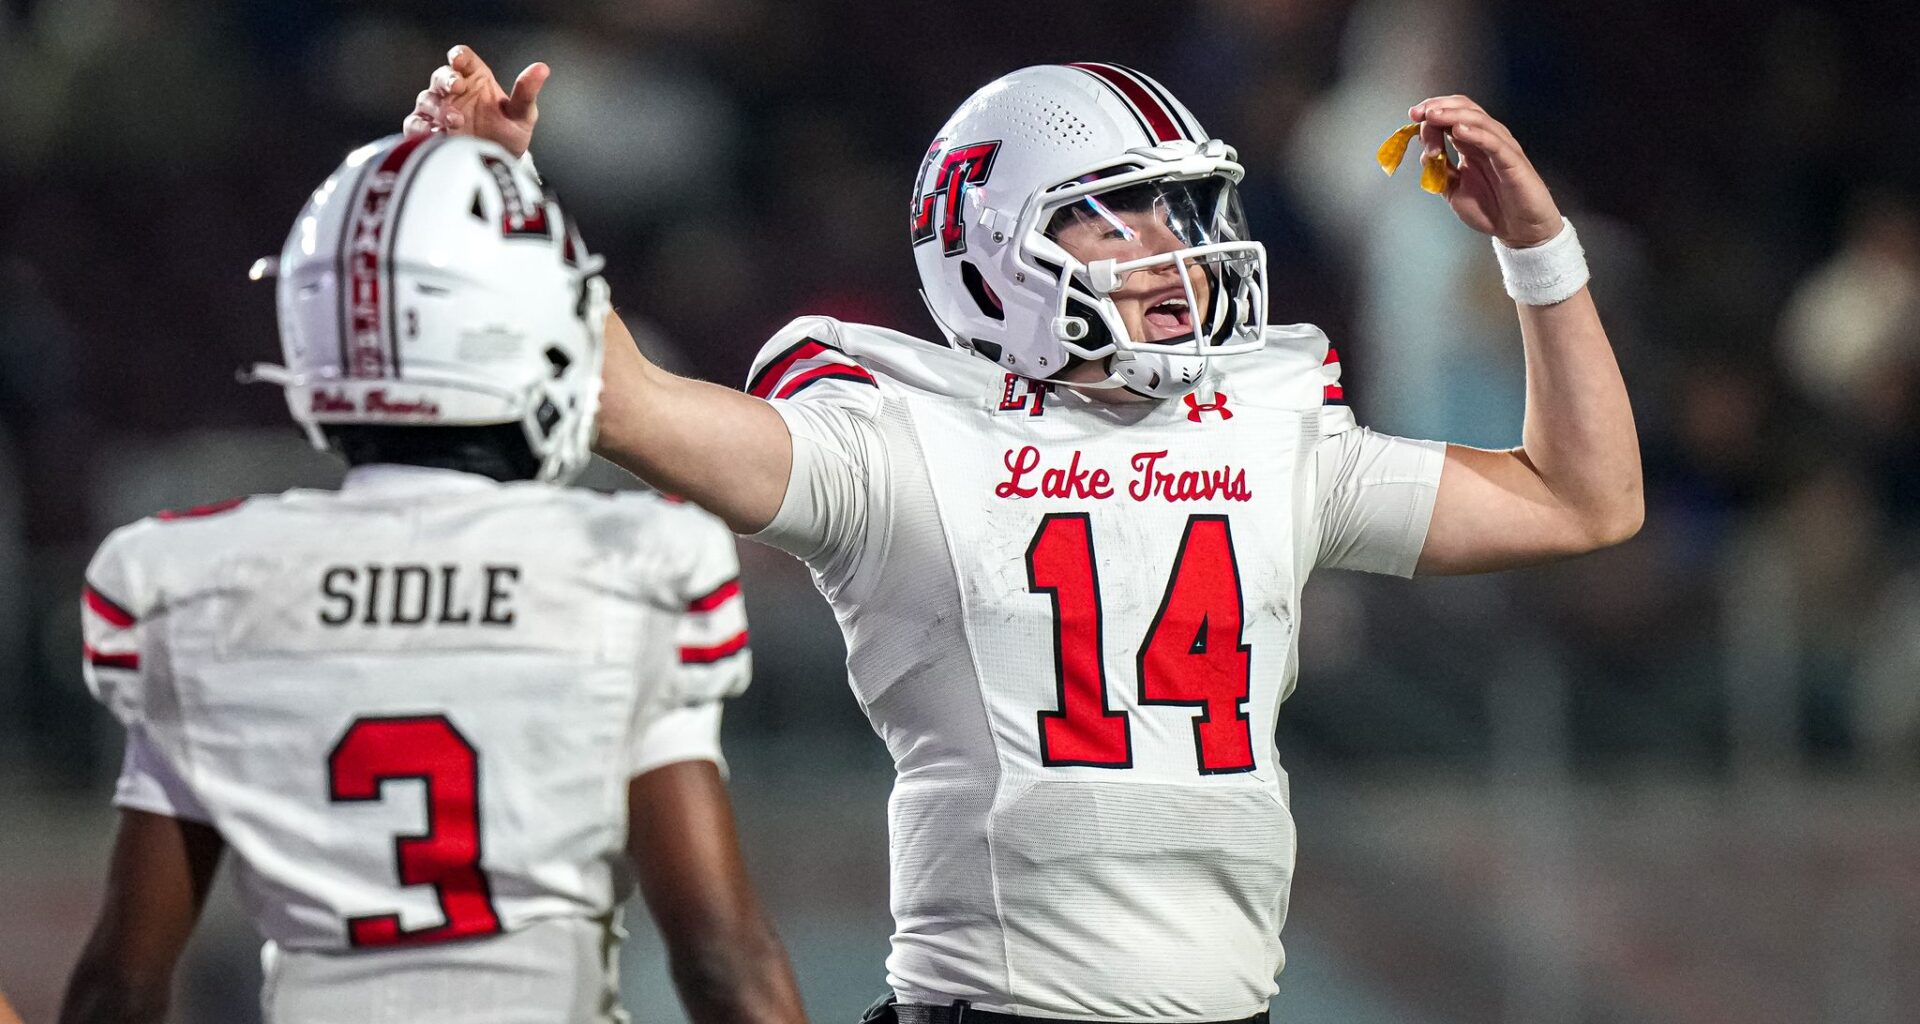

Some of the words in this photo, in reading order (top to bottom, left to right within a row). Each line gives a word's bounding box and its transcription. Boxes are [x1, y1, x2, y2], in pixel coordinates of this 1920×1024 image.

[911, 138, 1002, 258] LT
[998, 372, 1056, 417] LT
[995, 445, 1114, 500] Lake
[1128, 450, 1252, 502] Travis
[319, 563, 521, 627] SIDLE
[1025, 511, 1256, 775] 14
[328, 714, 503, 949] 3
